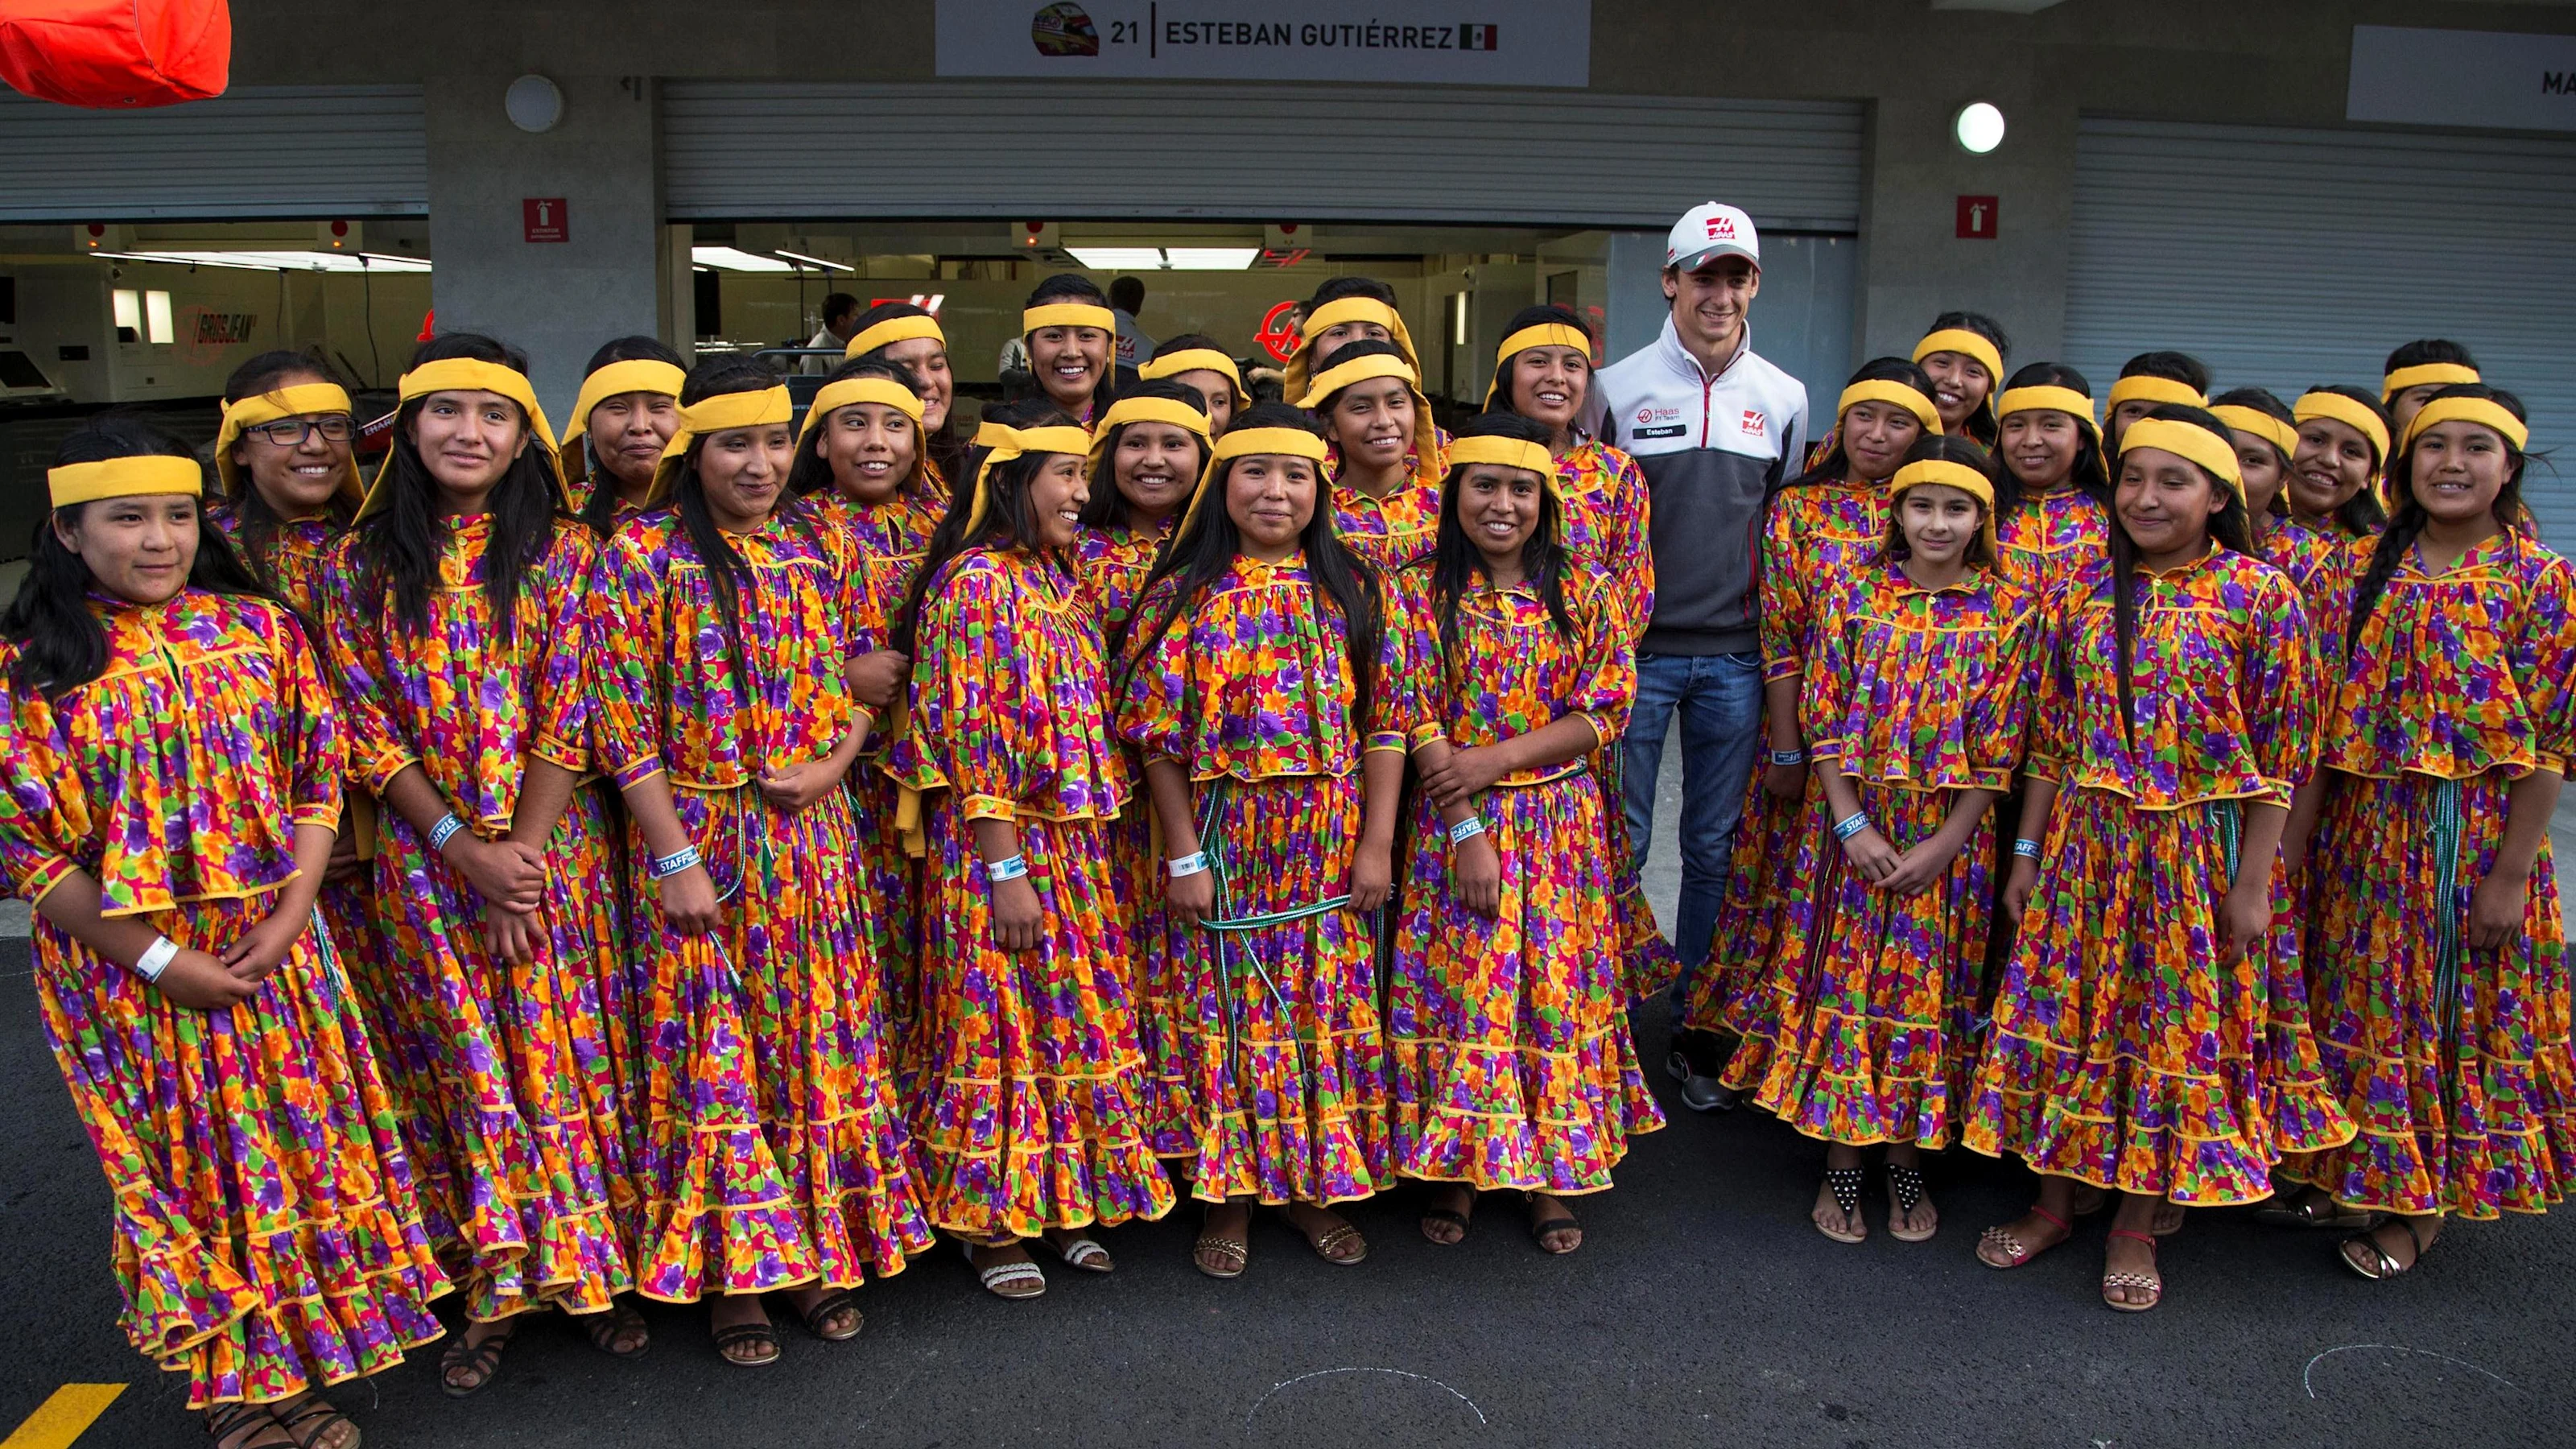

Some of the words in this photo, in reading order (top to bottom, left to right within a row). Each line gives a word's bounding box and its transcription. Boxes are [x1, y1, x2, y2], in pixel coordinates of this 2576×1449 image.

[1111, 21, 1138, 43] 21
[1166, 22, 1291, 46] ESTEBAN
[1300, 19, 1453, 49] GUTIÉRREZ
[197, 313, 253, 345] GROSJEAN
[1655, 407, 1680, 416] Haas
[431, 817, 456, 846] STAFF
[1454, 820, 1481, 838] STAFF
[1846, 815, 1867, 832] STAFF
[659, 853, 690, 873] STAFF
